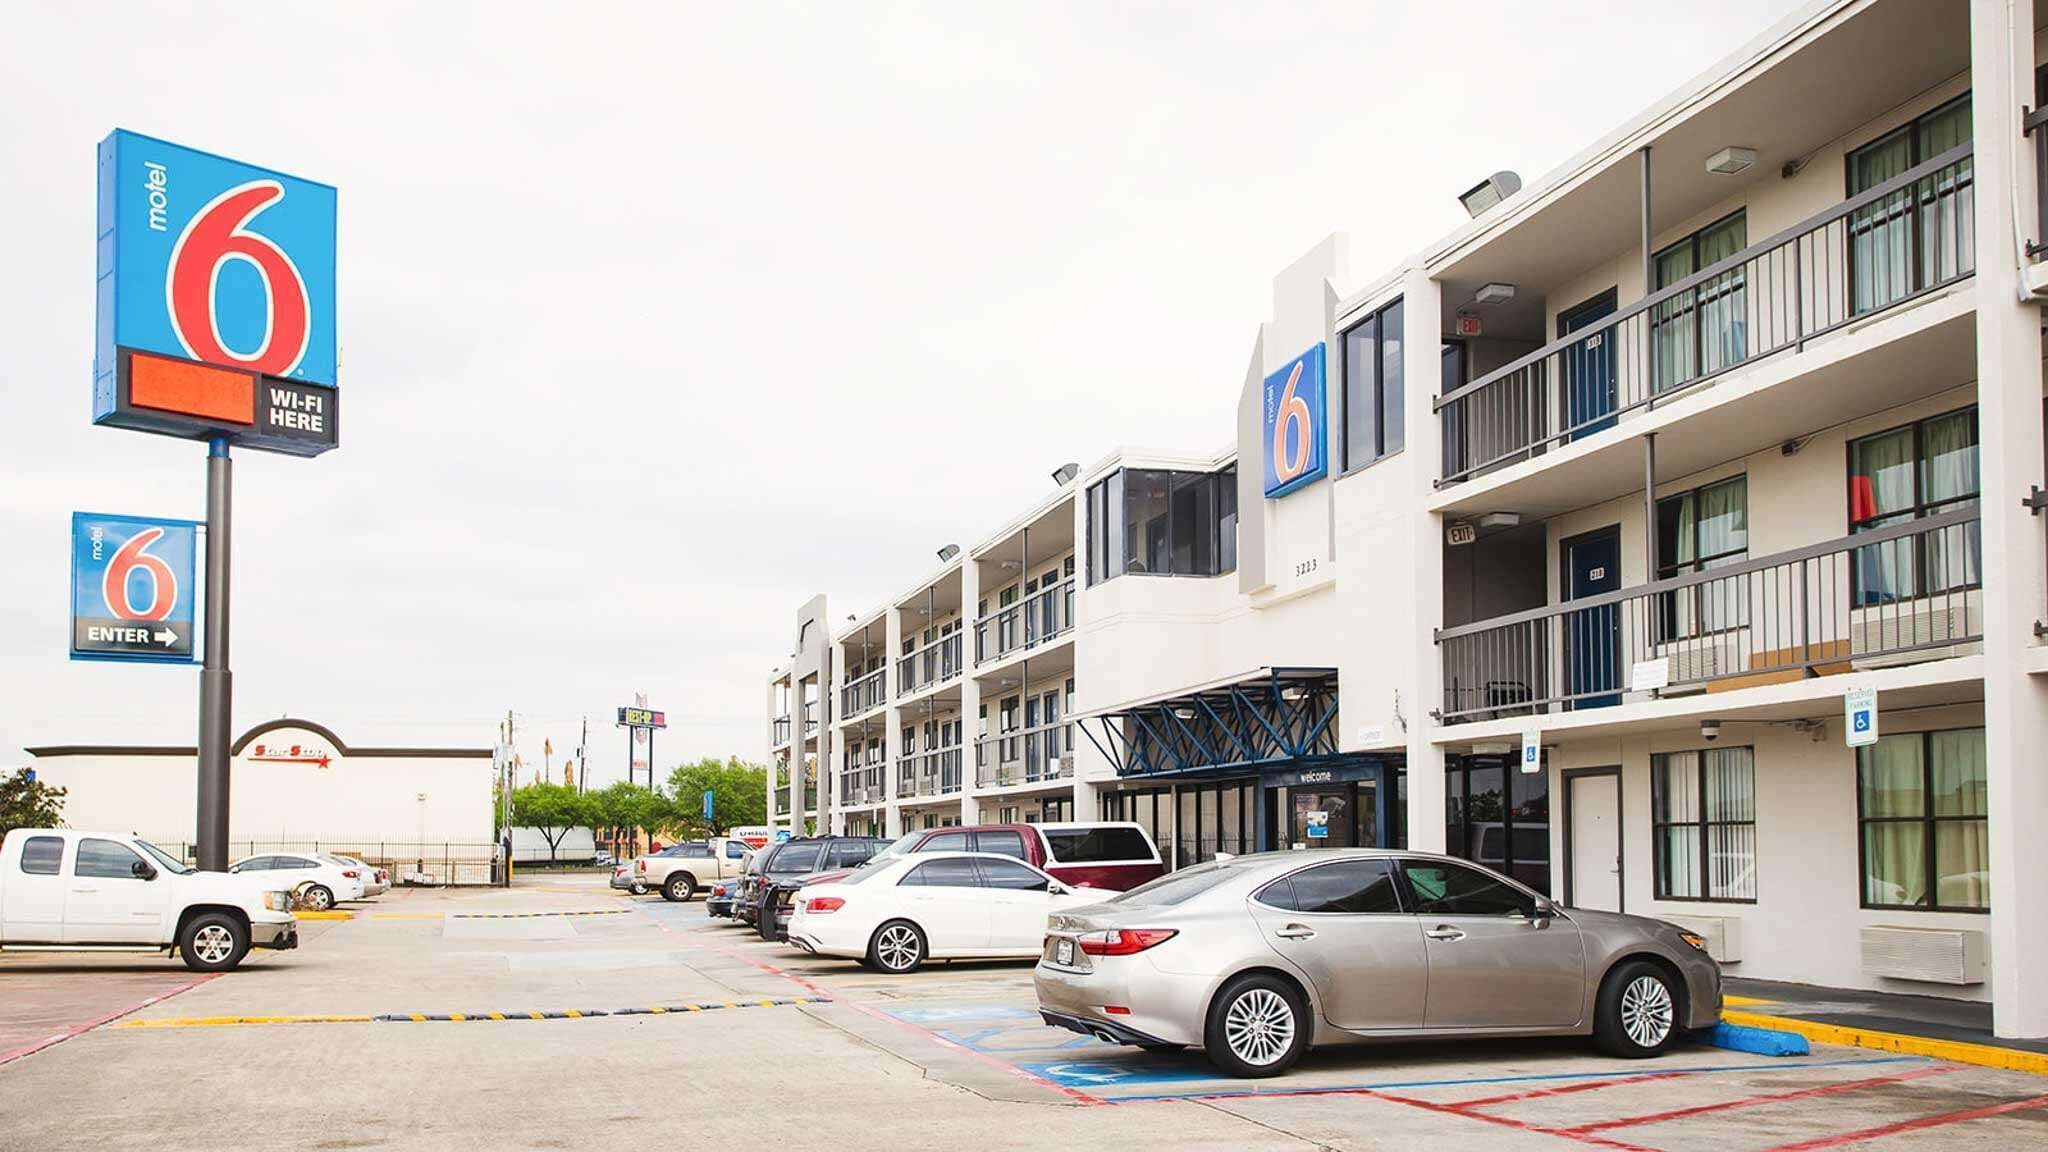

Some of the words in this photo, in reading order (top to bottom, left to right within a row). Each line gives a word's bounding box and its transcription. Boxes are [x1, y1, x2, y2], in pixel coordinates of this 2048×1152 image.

[144, 161, 168, 231] motel
[166, 179, 312, 377] 6
[270, 388, 322, 414] WI-FI
[270, 407, 323, 433] HERE
[1267, 385, 1275, 424] motel
[1274, 360, 1311, 484] 6
[1452, 526, 1471, 543] EXIT
[90, 527, 104, 560] motel
[102, 527, 178, 621] 6
[88, 626, 149, 643] ENTER
[1299, 770, 1333, 783] welcome
